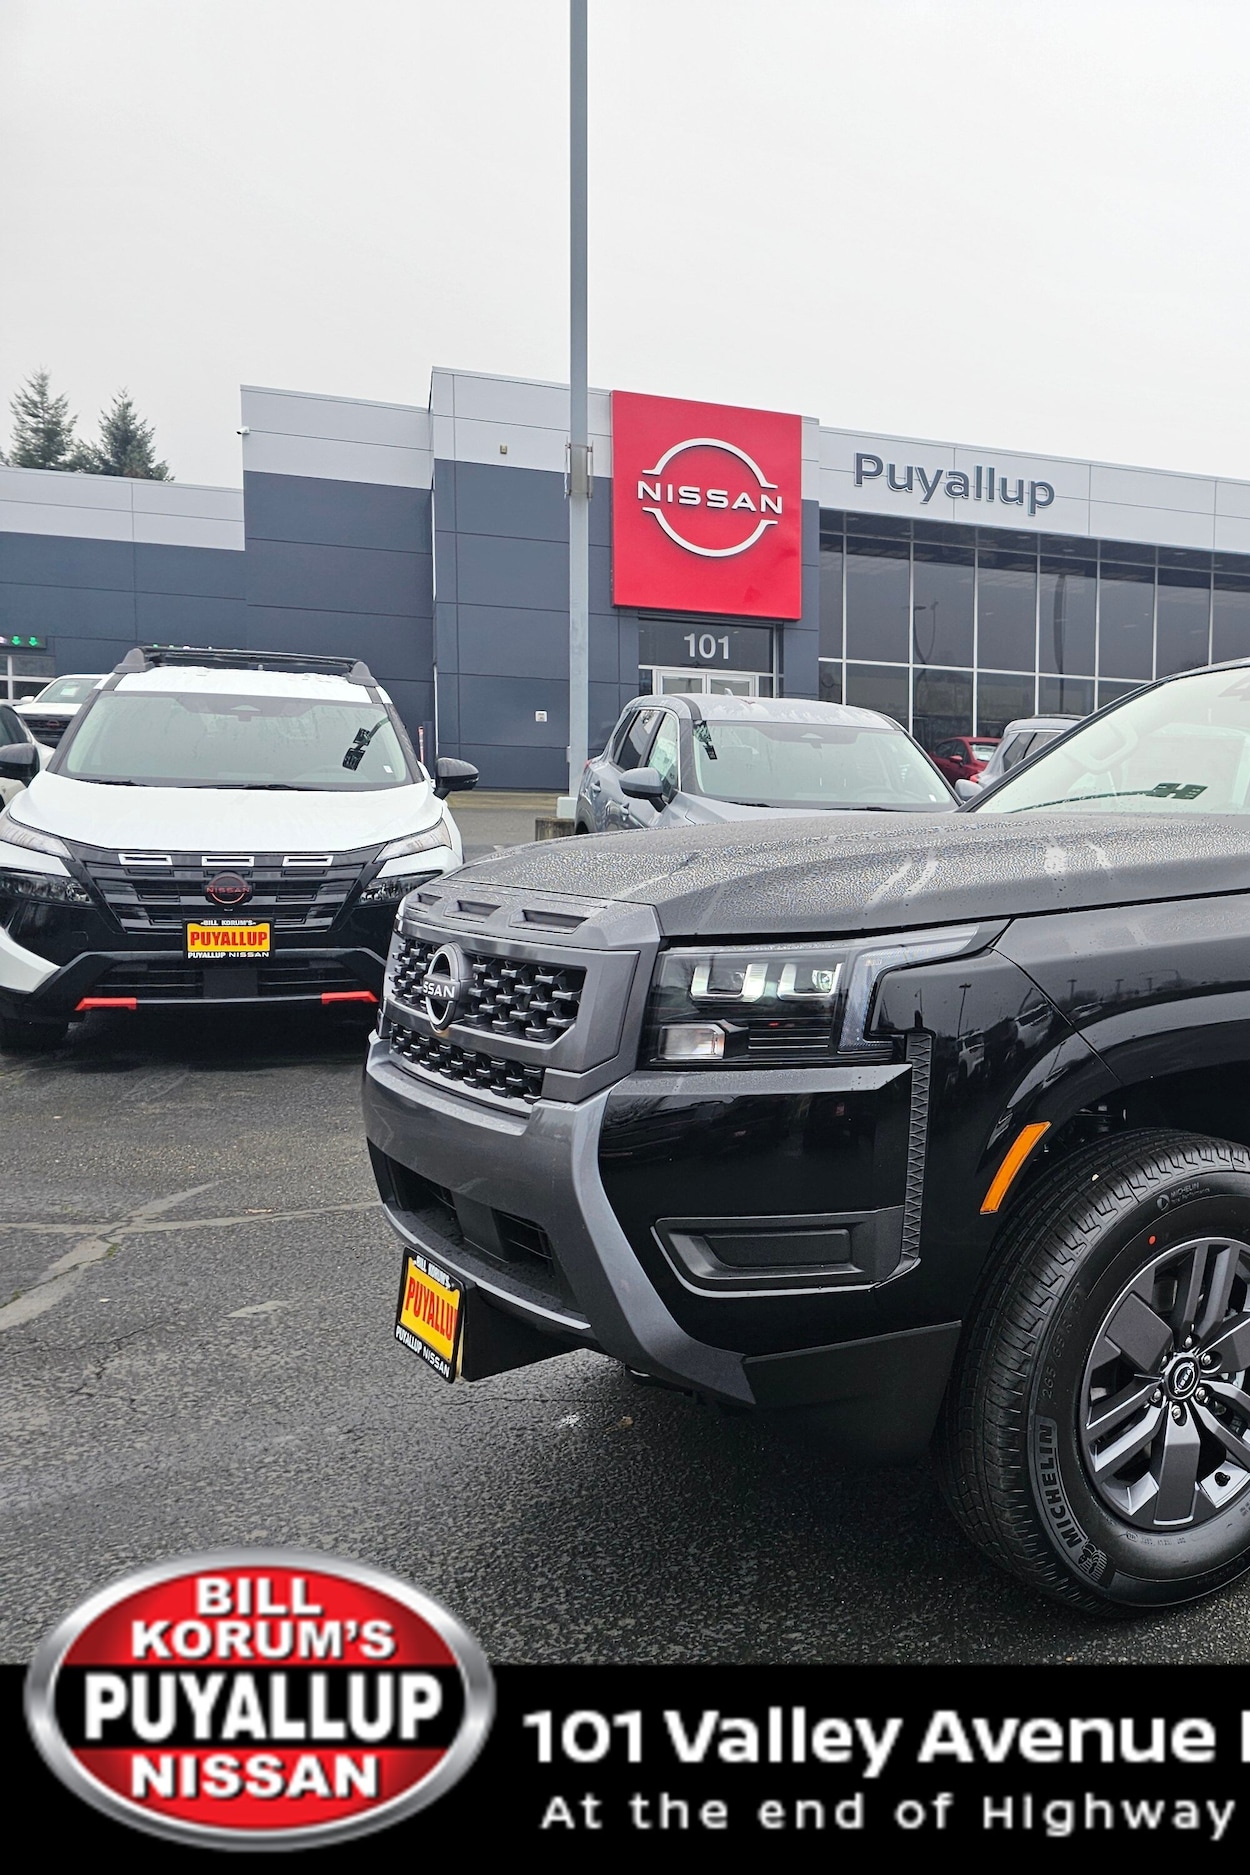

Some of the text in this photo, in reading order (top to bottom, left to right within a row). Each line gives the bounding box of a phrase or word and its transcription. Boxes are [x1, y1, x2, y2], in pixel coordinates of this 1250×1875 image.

[637, 480, 783, 515] NISSAN
[854, 452, 1055, 516] Puyallup
[684, 633, 729, 660] 101
[190, 931, 268, 947] PUYALLUP
[422, 981, 456, 998] SSAN
[404, 1275, 460, 1341] PUYALLU
[395, 1325, 451, 1378] PUYALLUP NISSAN
[1038, 1423, 1083, 1550] MICHELIN
